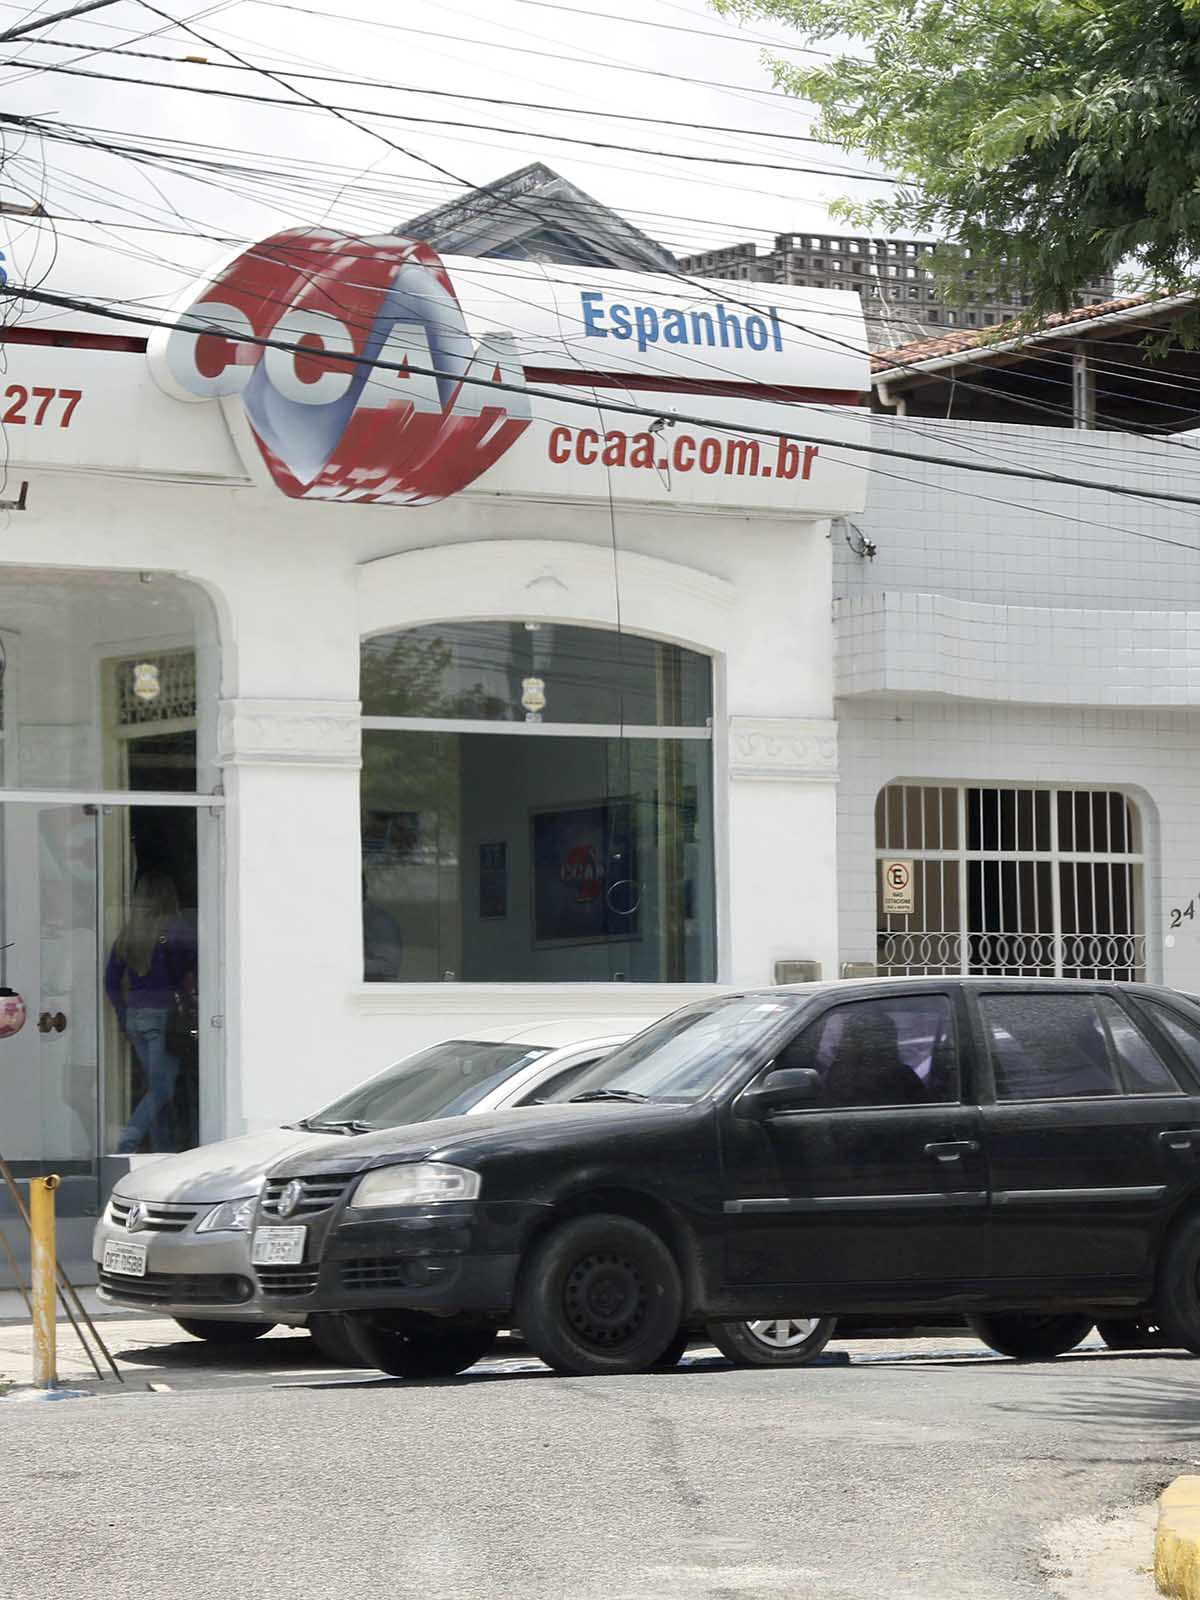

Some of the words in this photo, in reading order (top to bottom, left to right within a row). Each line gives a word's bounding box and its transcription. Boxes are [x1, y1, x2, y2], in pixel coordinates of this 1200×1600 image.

[580, 290, 784, 353] Espanhol
[167, 302, 533, 421] CCAA
[2, 384, 83, 428] 277
[548, 425, 819, 481] ccaa.com.br
